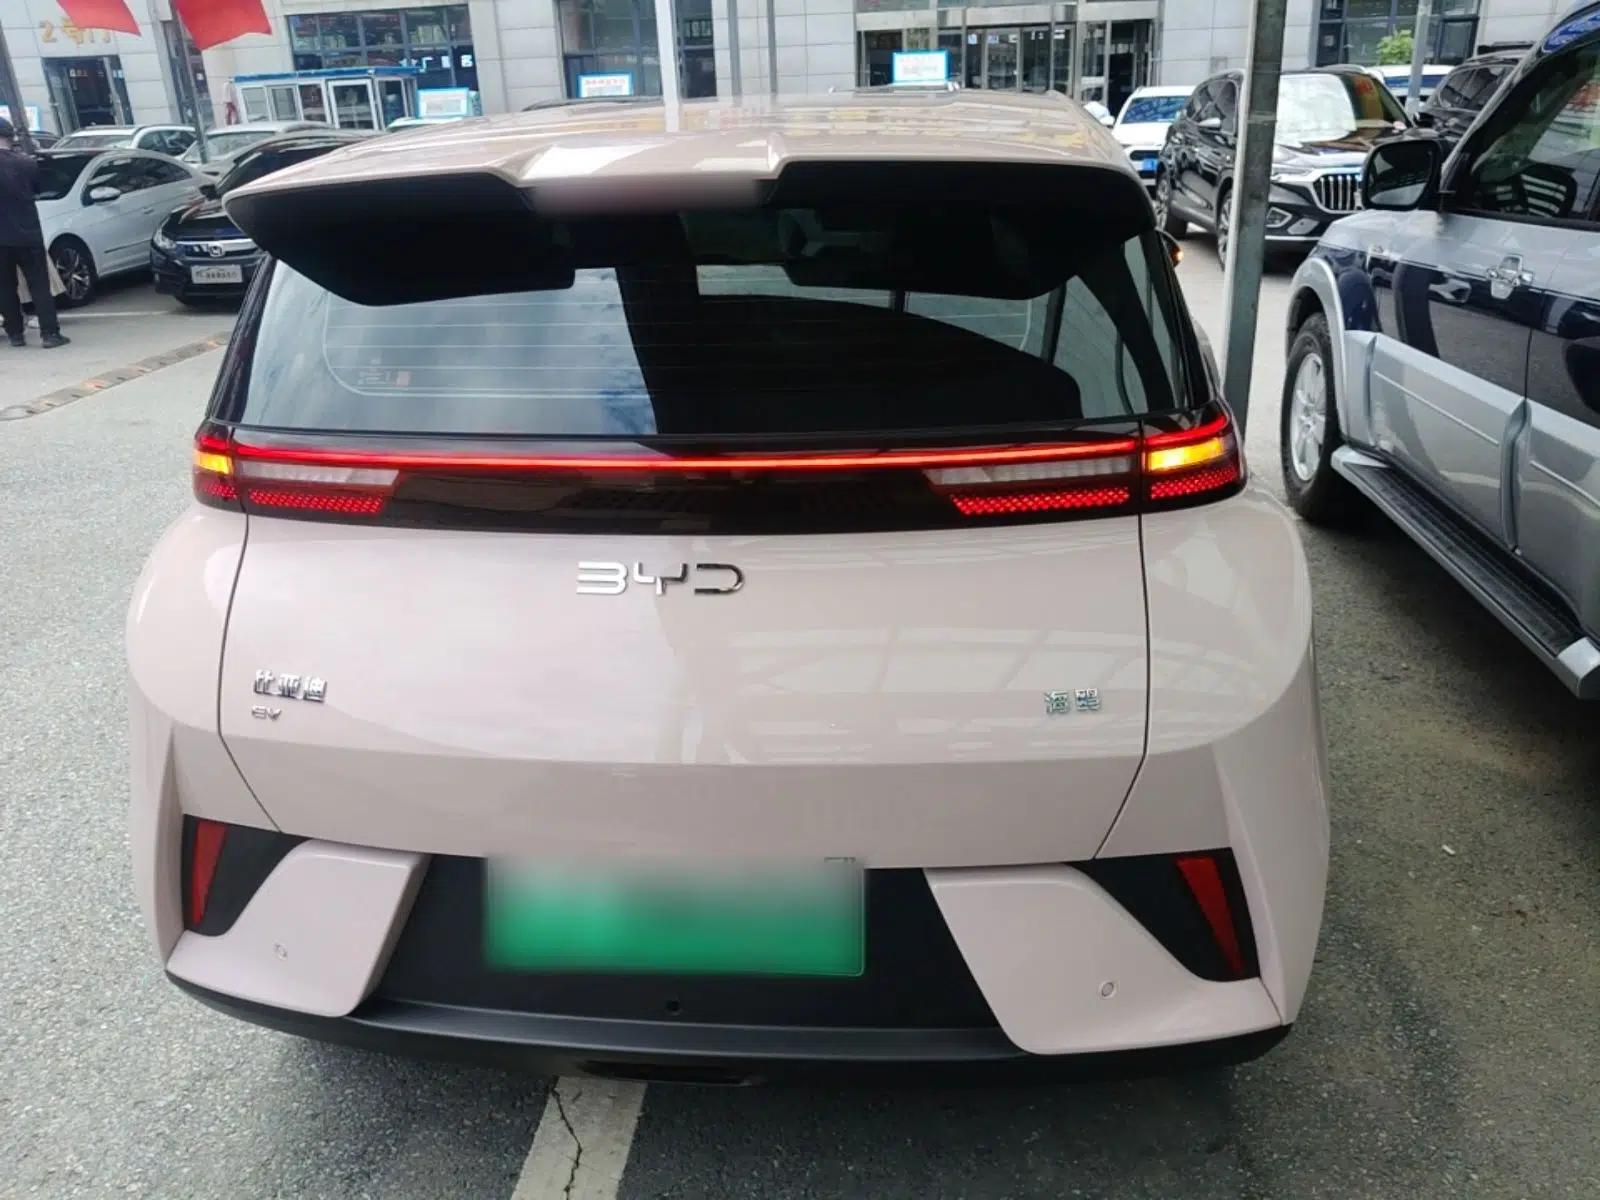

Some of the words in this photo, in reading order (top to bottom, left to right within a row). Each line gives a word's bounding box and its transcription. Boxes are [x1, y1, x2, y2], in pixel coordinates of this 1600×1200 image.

[576, 561, 744, 596] BYD
[253, 669, 327, 703] 比亚迪
[251, 705, 282, 721] EV
[1043, 689, 1101, 713] 海鸥
